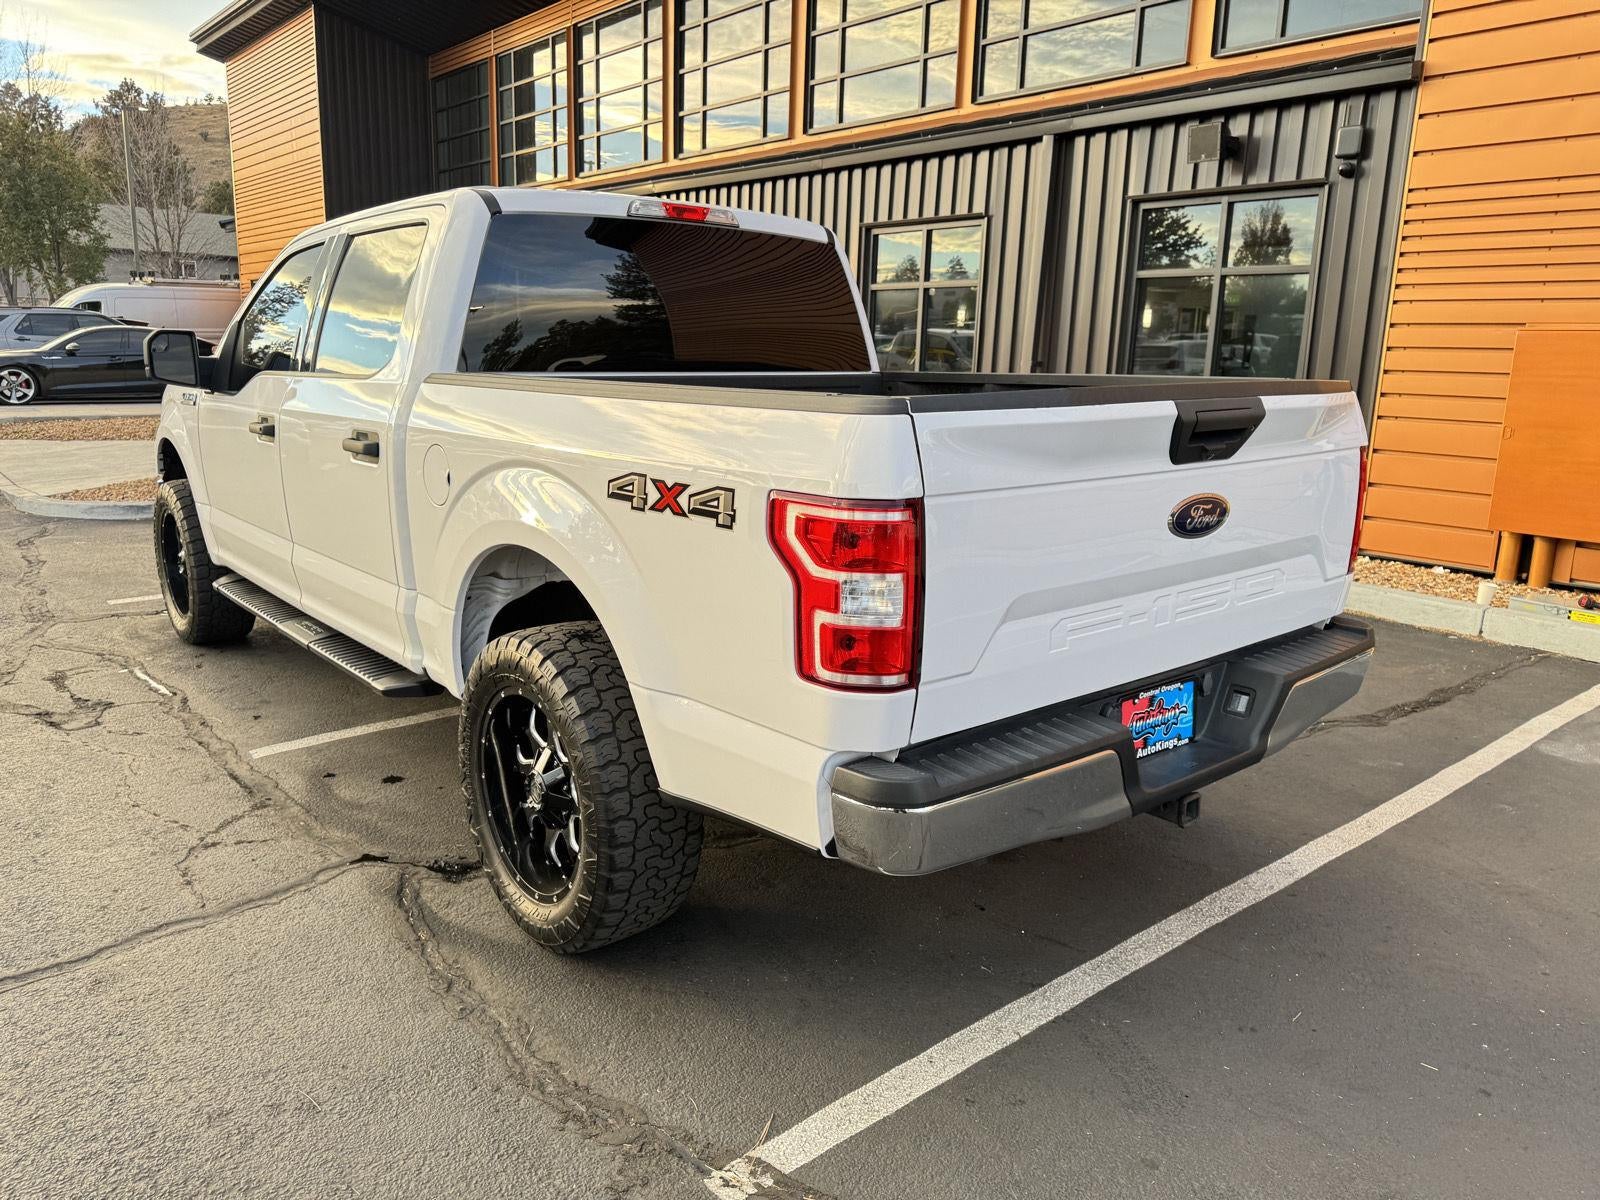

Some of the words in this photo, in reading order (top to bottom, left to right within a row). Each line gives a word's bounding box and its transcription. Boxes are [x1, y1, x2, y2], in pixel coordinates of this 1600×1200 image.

[1186, 502, 1220, 530] Ford
[1049, 567, 1287, 654] F-150
[1138, 688, 1161, 700] Central
[1160, 682, 1182, 693] Oregon
[1136, 737, 1190, 759] AutoKings.com
